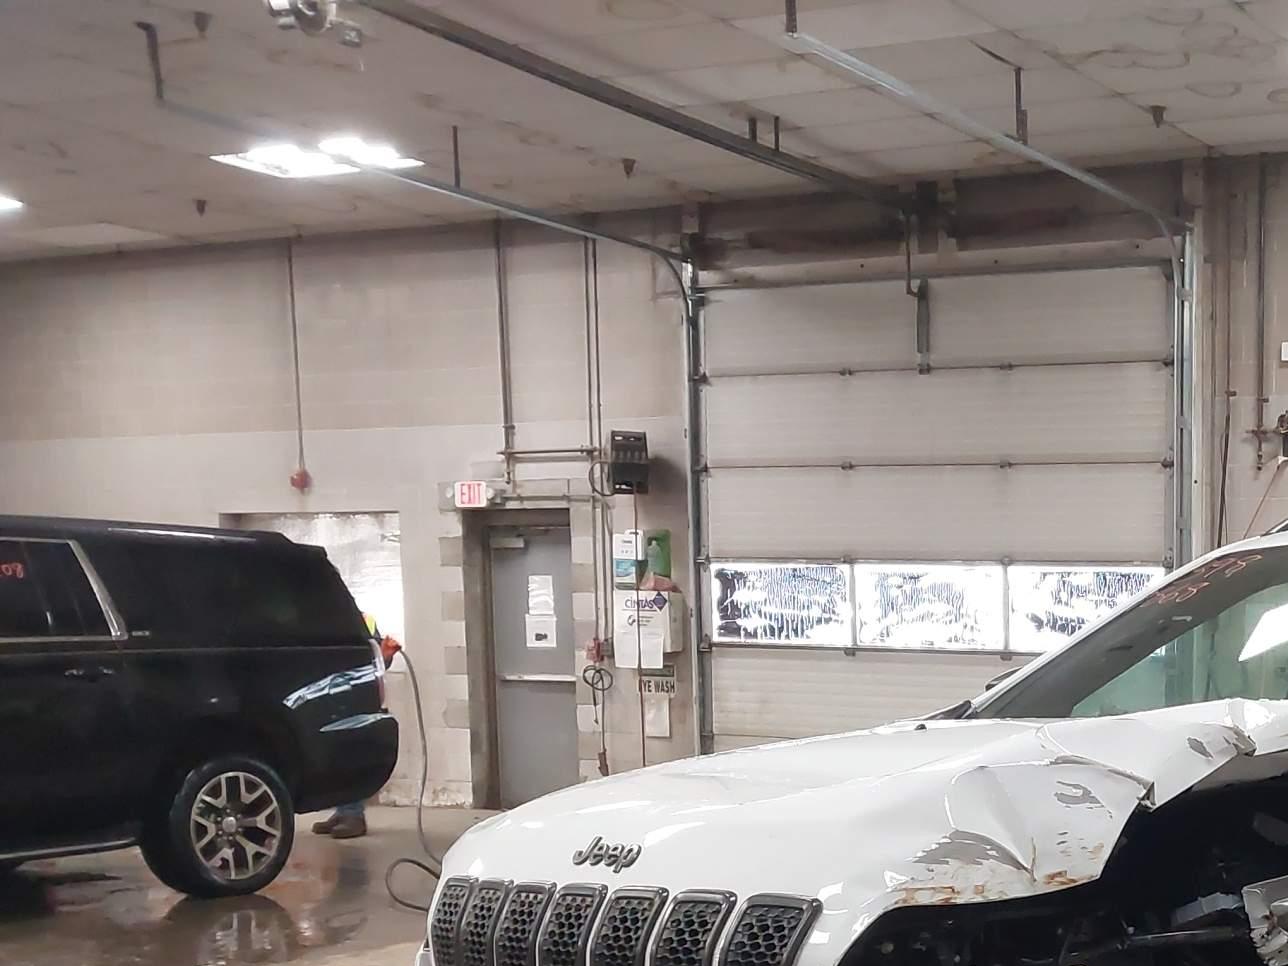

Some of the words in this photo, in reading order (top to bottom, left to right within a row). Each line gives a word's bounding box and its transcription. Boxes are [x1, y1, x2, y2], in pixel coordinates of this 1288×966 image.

[460, 483, 482, 505] EXIT
[653, 680, 676, 694] WASH
[572, 835, 642, 874] Jeep
